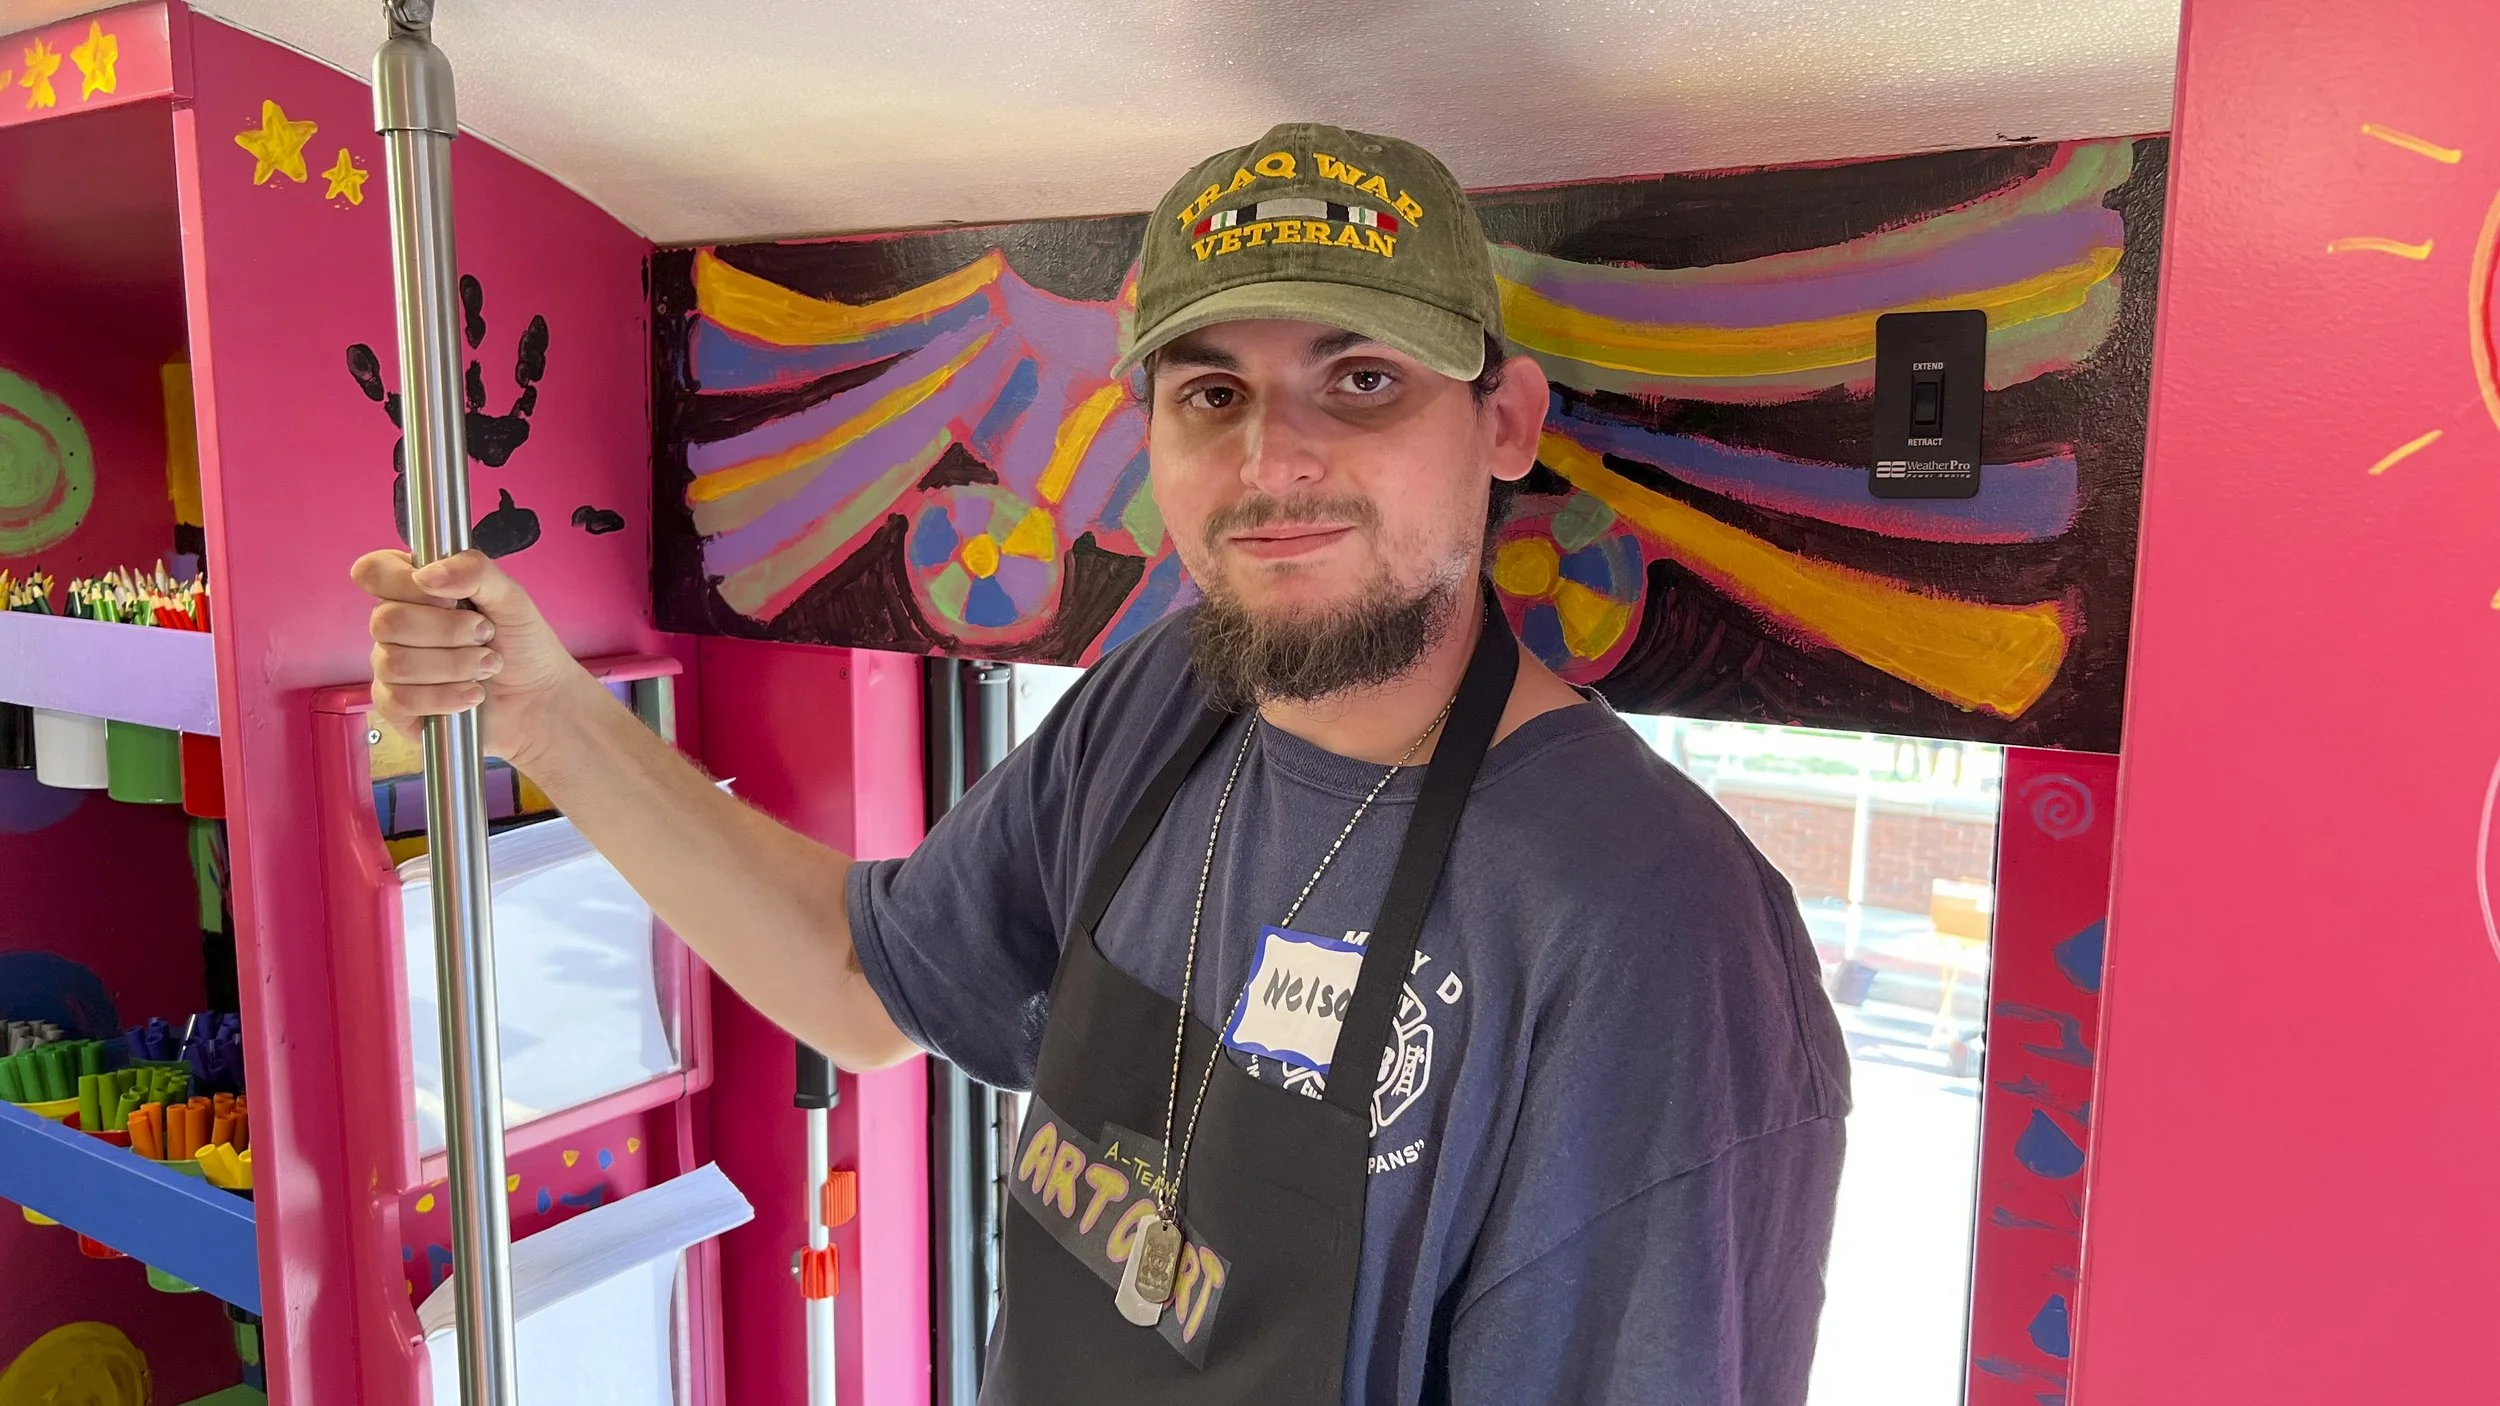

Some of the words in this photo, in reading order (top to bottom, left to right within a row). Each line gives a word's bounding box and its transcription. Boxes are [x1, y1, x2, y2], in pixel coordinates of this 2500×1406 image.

[1176, 151, 1297, 231] IRAQ
[1313, 152, 1425, 229] WAR
[1191, 220, 1398, 262] VETERAN
[1912, 362, 1944, 371] EXTEND
[1907, 438, 1944, 447] RETRACT
[1262, 967, 1352, 1022] Nelso
[1017, 1121, 1130, 1235] ART
[1106, 1198, 1225, 1343] CRT
